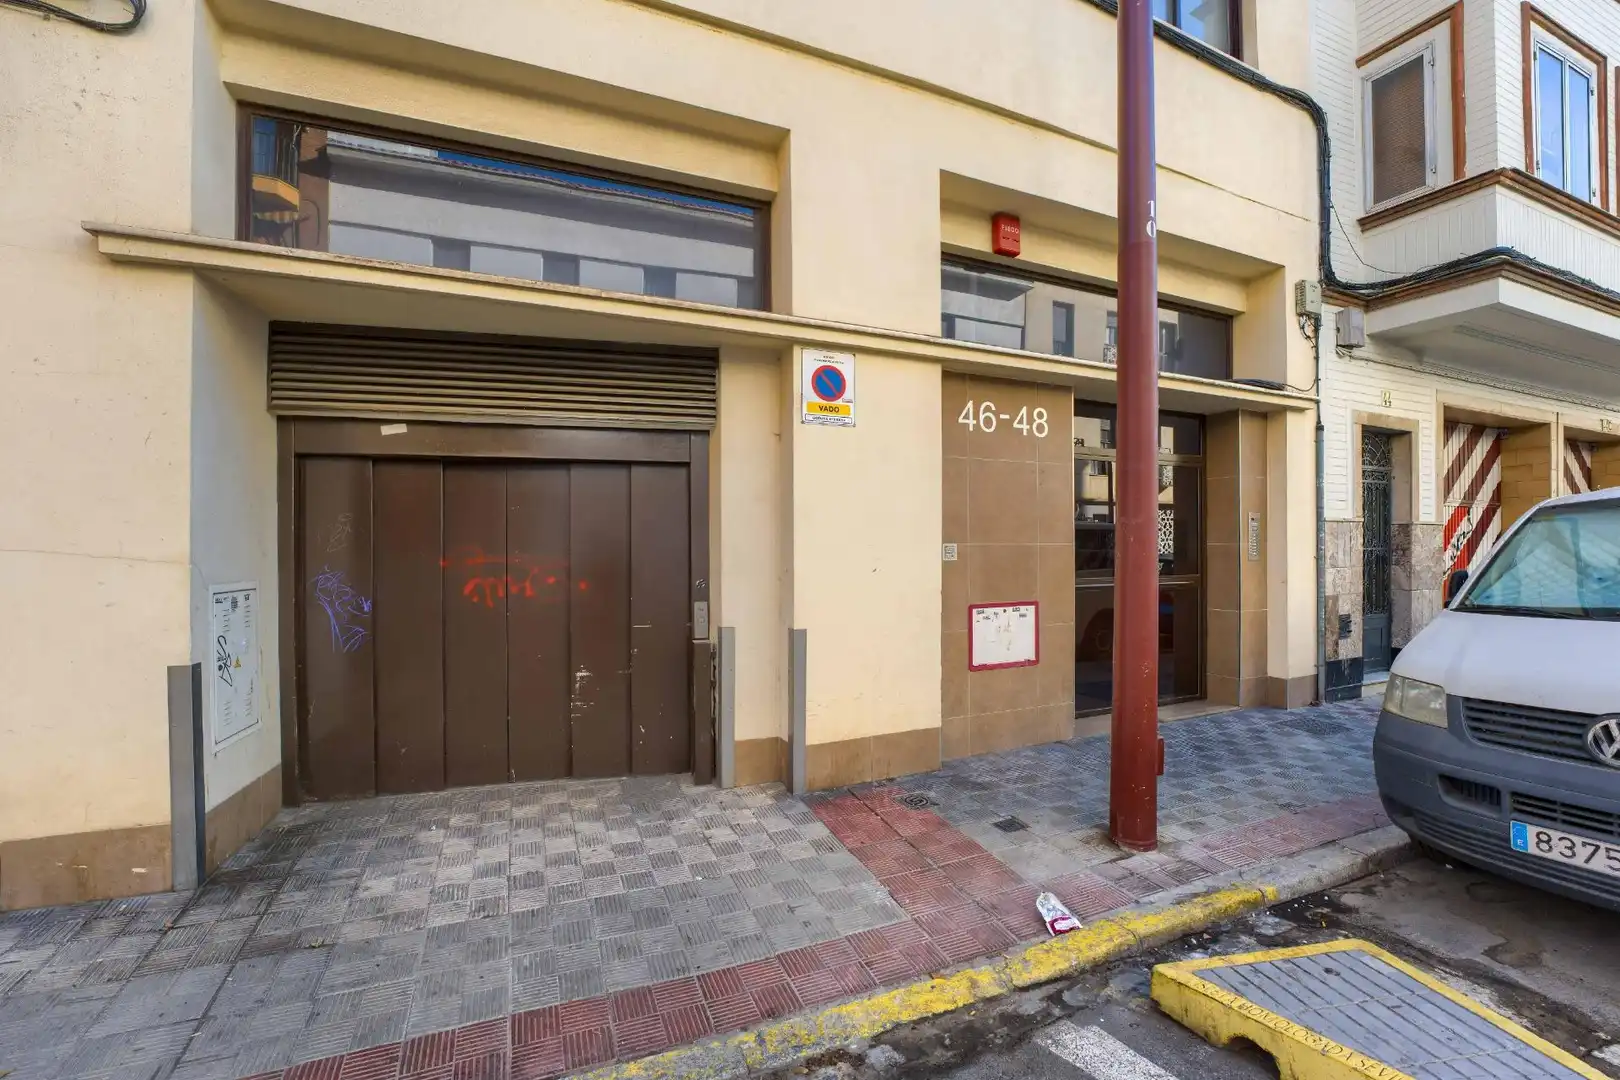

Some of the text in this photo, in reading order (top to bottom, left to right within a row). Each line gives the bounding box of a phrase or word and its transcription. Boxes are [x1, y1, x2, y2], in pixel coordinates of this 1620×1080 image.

[818, 405, 839, 413] VADO
[957, 400, 1049, 438] 46-48
[1535, 831, 1620, 871] 8375
[1237, 1002, 1353, 1061] HOMOLOGADA
